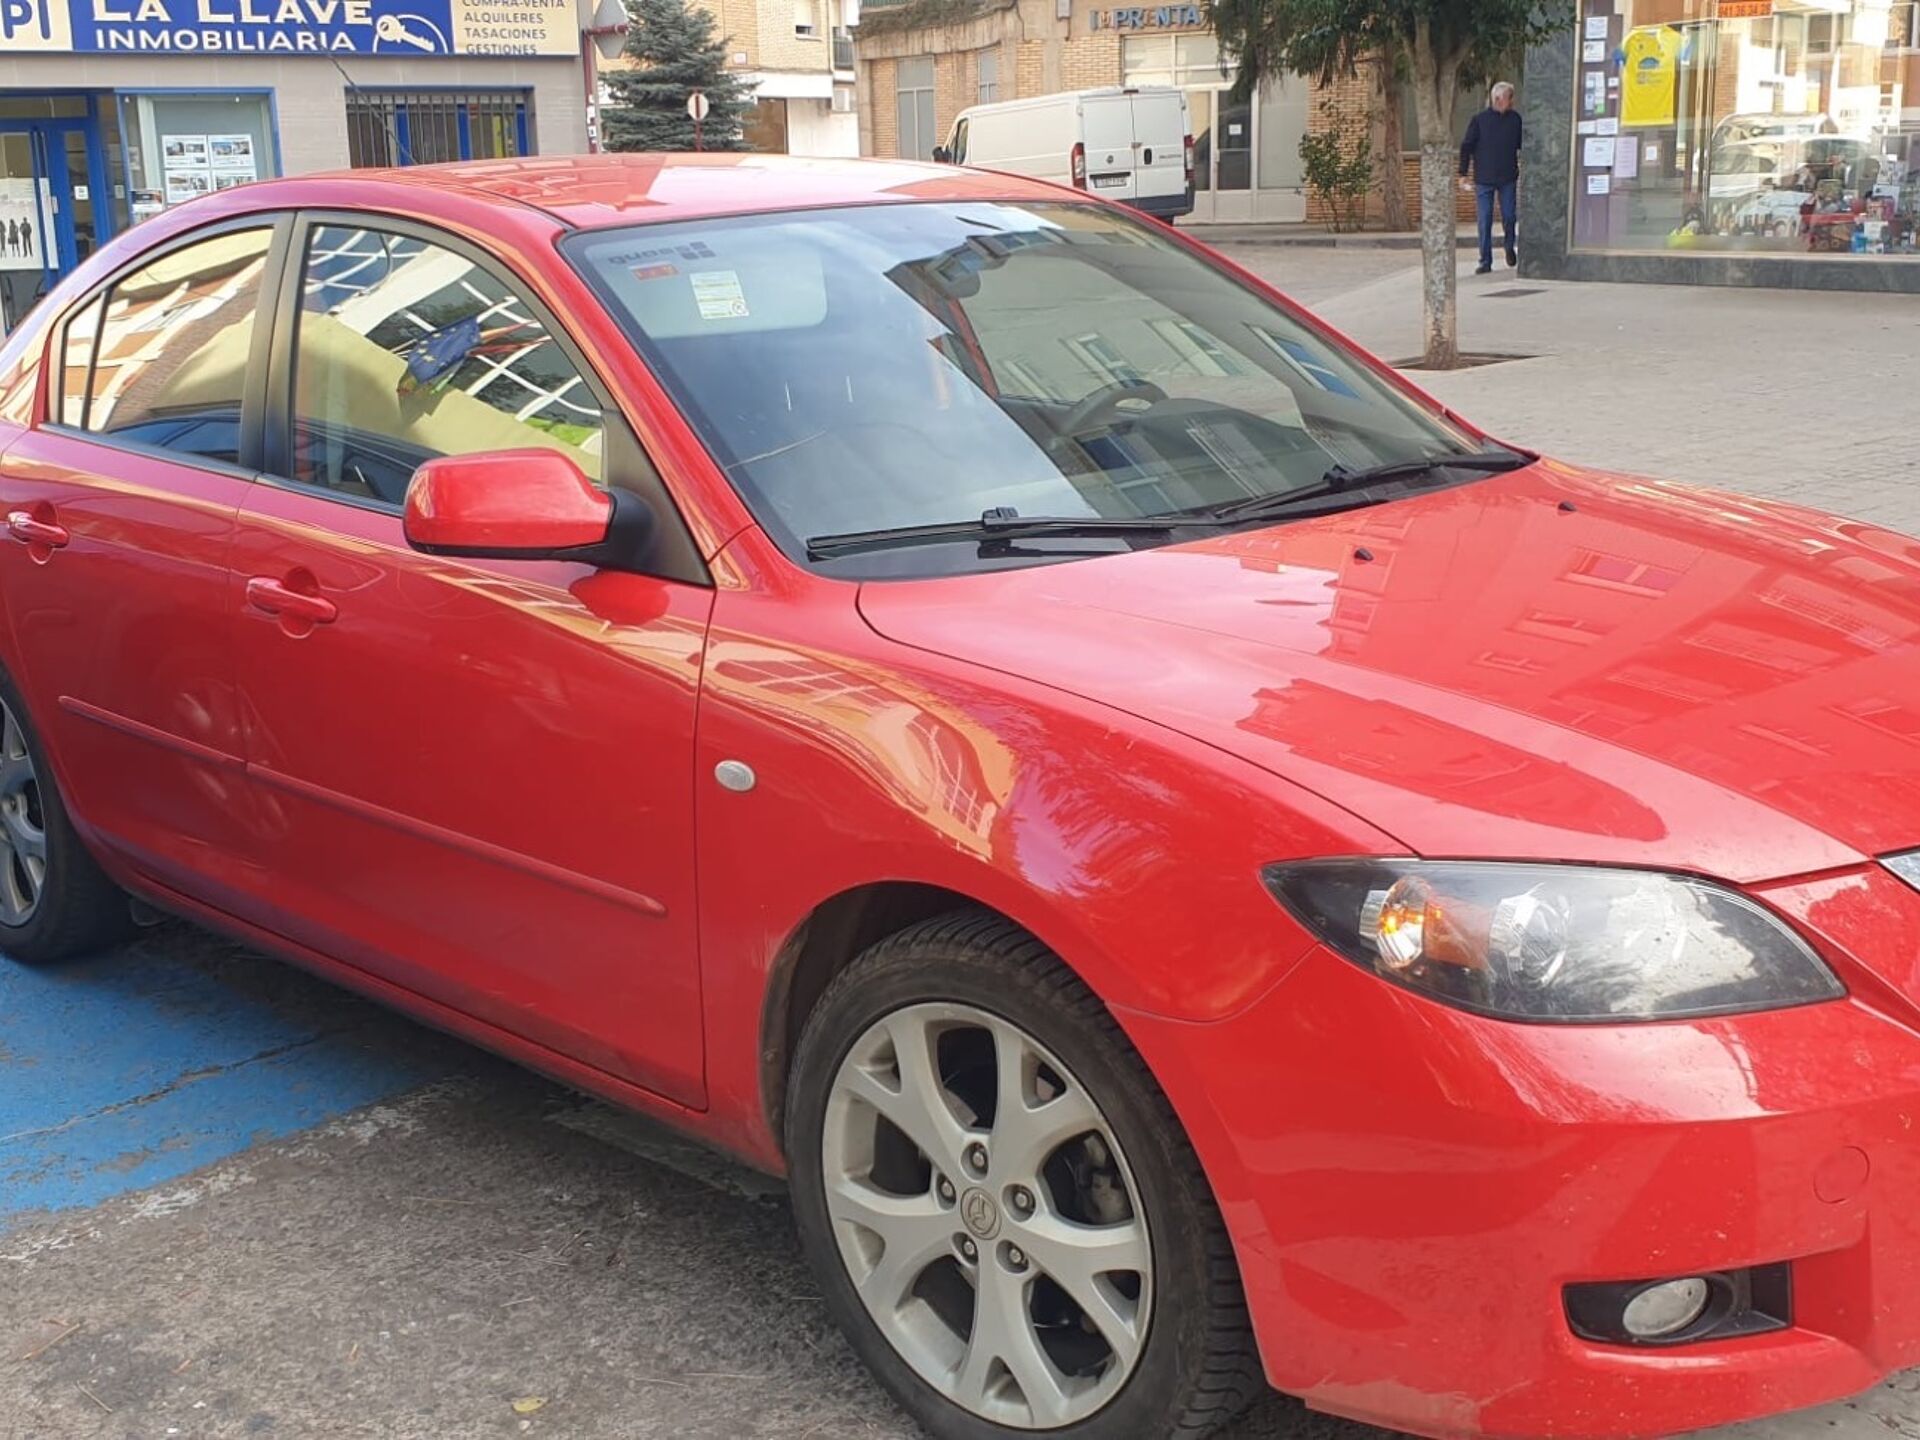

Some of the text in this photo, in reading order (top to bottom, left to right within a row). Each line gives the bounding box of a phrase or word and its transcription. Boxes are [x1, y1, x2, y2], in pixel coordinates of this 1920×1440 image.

[92, 0, 372, 25] LA LLAVE
[464, 12, 544, 24] ALQUILERES
[465, 27, 547, 39] TASACIONES
[95, 29, 356, 50] INMOBILIARIA
[466, 43, 537, 55] GESTIONES
